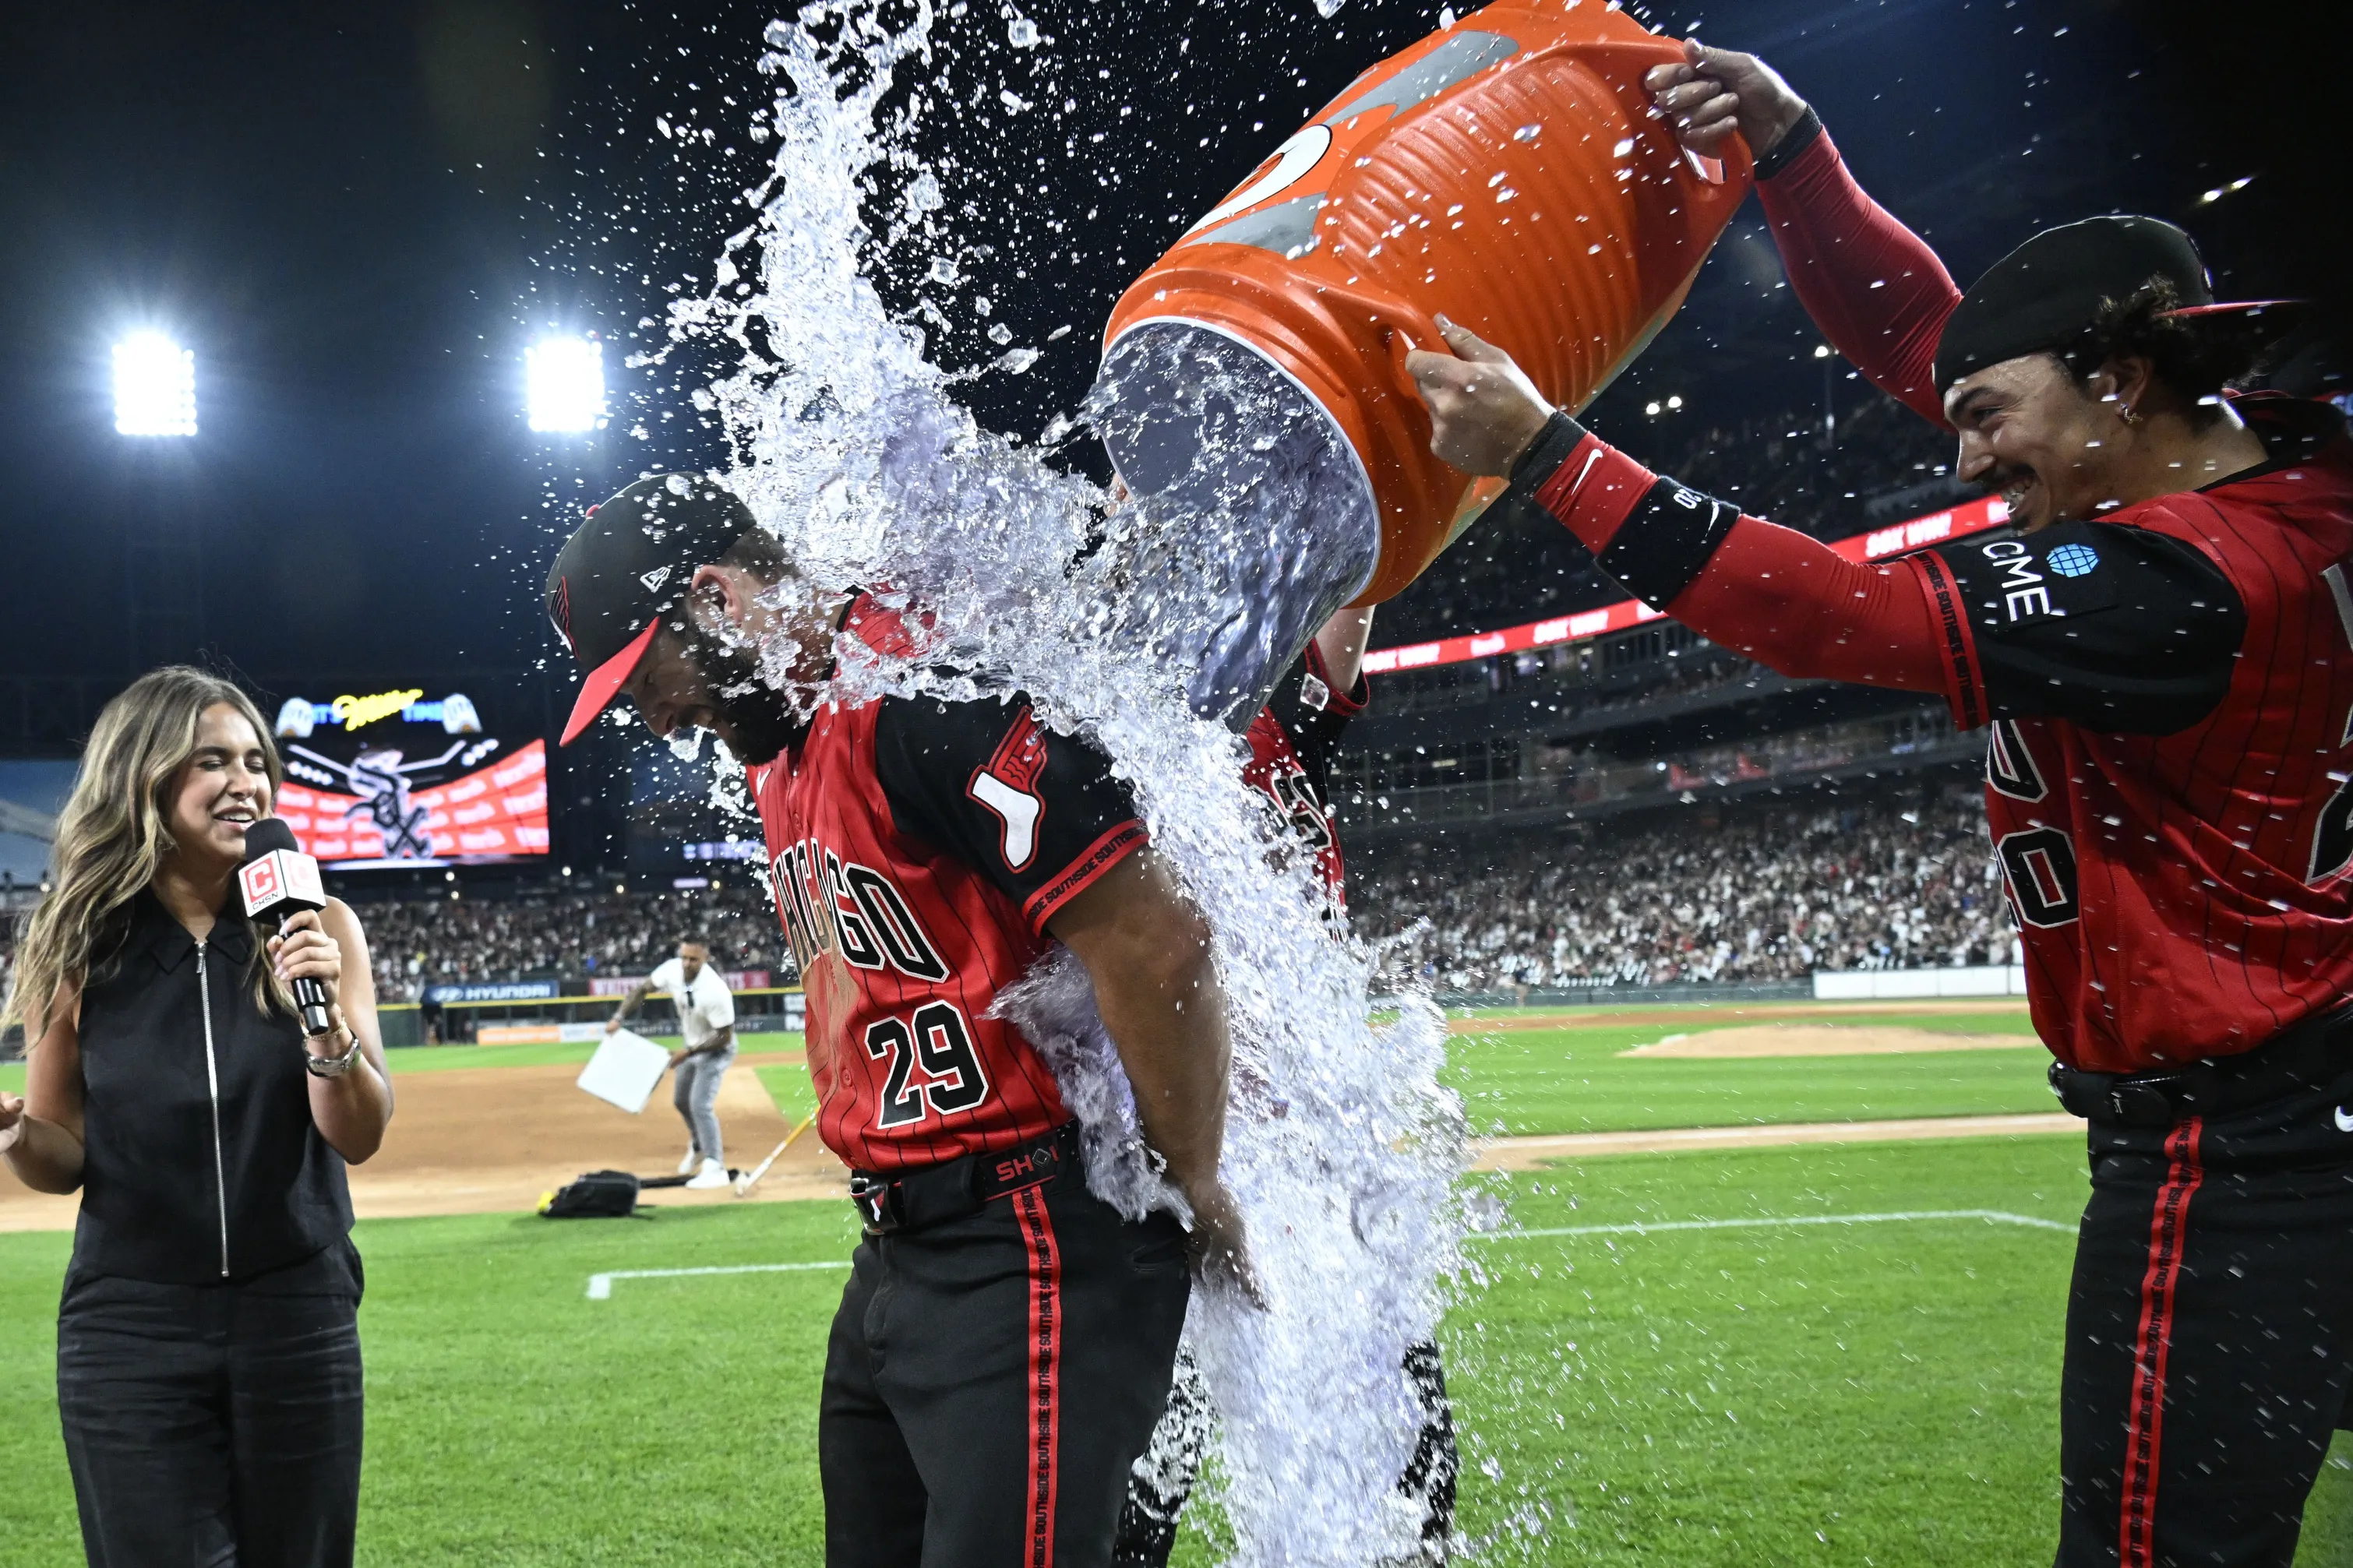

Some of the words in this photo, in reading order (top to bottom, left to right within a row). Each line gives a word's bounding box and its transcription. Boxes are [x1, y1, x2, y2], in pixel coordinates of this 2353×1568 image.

[1983, 541, 2051, 622] CME
[252, 890, 279, 911] CHSN
[1045, 856, 1098, 904] SOUTHSIDE
[465, 984, 551, 1000] HYUNDAI
[864, 999, 990, 1130] 29
[1038, 1290, 1053, 1346] SOUTHSIDE
[1038, 1347, 1053, 1406] SOUTHSIDE
[1037, 1408, 1051, 1470] SOUTHSIDE
[1034, 1471, 1050, 1535] SOUTHSIDE
